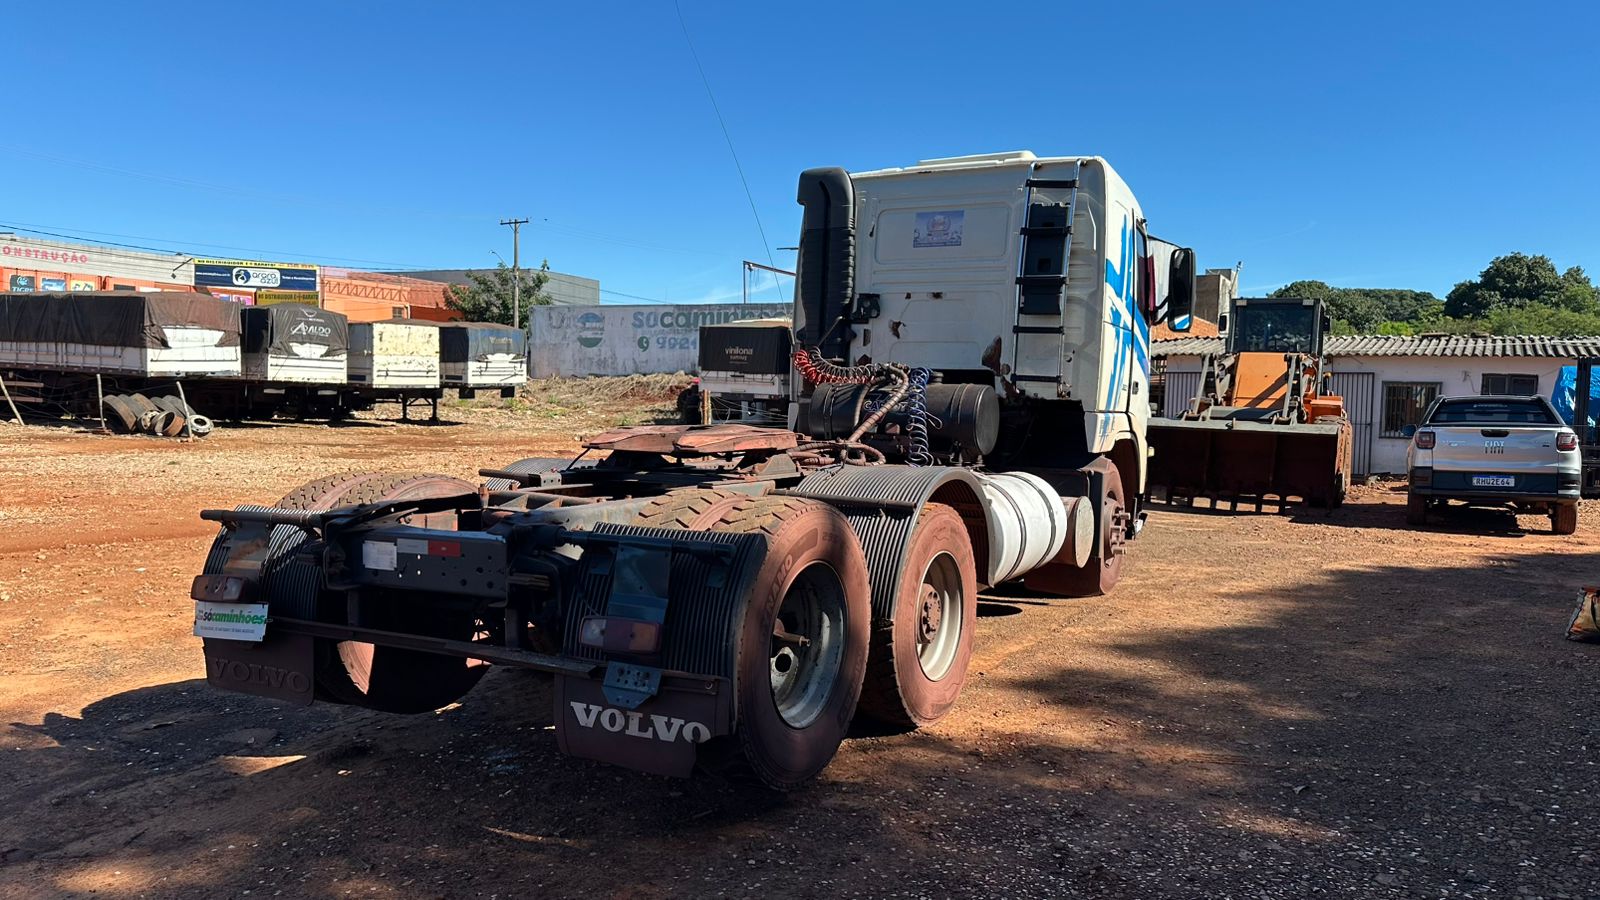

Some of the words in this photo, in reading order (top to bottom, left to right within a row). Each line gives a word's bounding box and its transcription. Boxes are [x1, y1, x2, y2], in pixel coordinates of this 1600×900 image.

[260, 277, 278, 285] azul
[1484, 440, 1505, 454] FIAT
[215, 659, 310, 693] VOLVO
[570, 701, 711, 744] VOLVO
